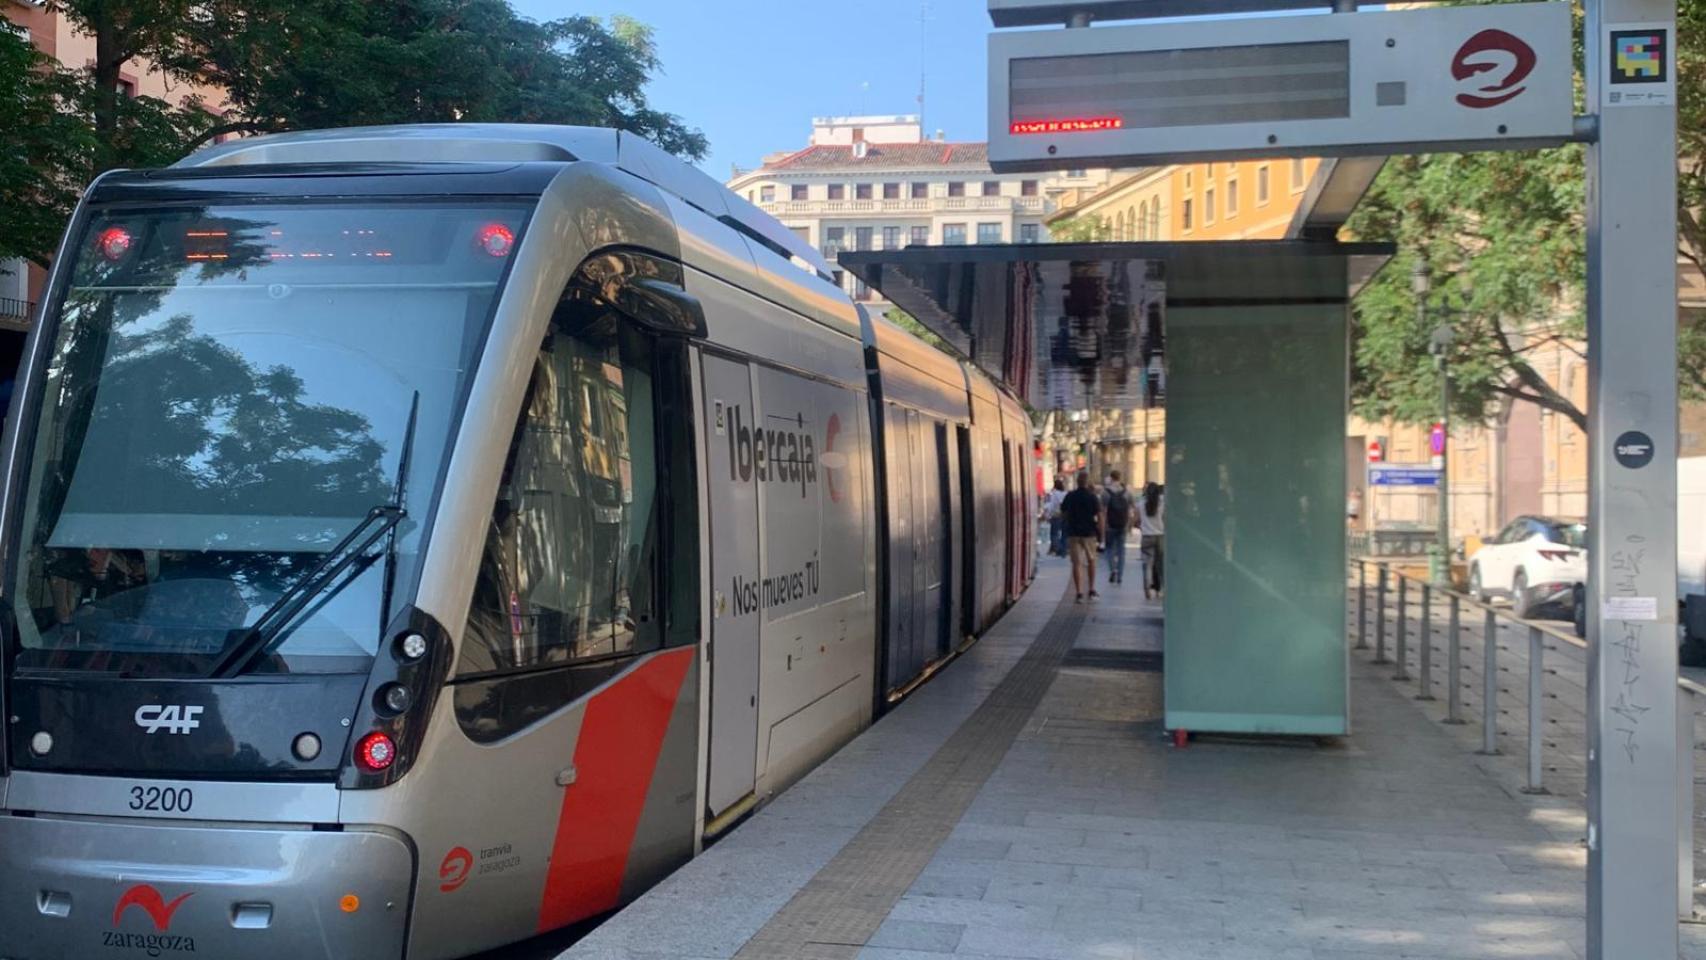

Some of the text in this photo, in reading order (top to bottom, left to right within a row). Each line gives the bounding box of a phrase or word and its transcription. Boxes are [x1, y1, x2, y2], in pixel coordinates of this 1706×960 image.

[727, 404, 817, 498] Ibercaja
[732, 550, 820, 616] Nos mueves TÚ
[134, 705, 204, 734] CAF
[129, 786, 193, 812] 3200
[102, 931, 195, 957] zaragoza
